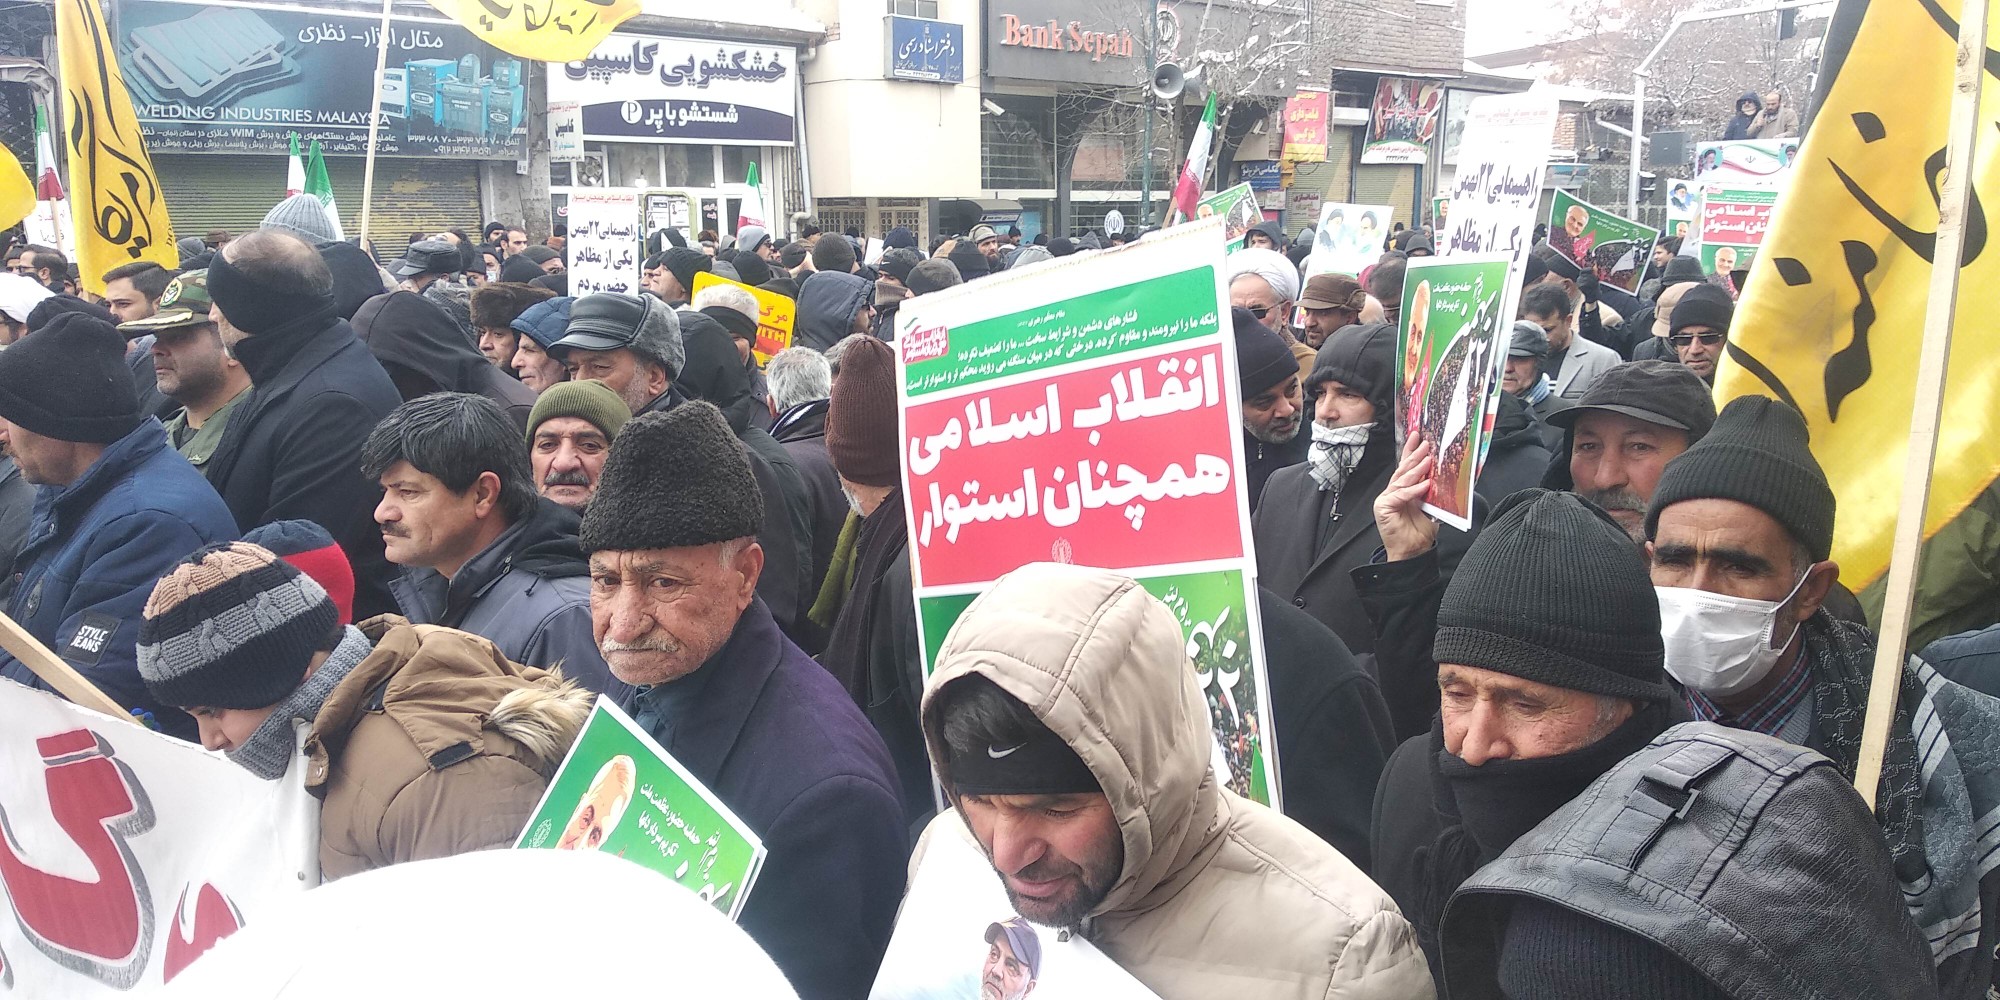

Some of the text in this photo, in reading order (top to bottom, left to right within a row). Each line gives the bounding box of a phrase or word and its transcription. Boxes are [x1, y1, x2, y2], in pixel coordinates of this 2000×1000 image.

[298, 22, 346, 44] نظری
[401, 29, 444, 50] متال
[1000, 14, 1133, 62] Bank Sepah
[899, 32, 955, 60] دفتر اسناد رسمی
[564, 40, 787, 88] خشکشویی کاسپین
[133, 104, 391, 126] WELDING INDUSTRIES MALAYSA
[230, 128, 254, 138] WIM
[281, 129, 303, 140] جش
[362, 143, 381, 151] C2
[1454, 162, 1539, 210] راهپیمایی ۲۲ بهمن
[1705, 205, 1756, 219] اسلامی
[588, 220, 600, 236] ۲۲
[599, 222, 637, 243] راهپیمایی
[1703, 220, 1746, 235] استوار
[1446, 218, 1482, 257] مظاهر
[1501, 225, 1523, 273] یک
[573, 246, 633, 271] یکی از مظاهر
[1104, 309, 1138, 331] فشارهای
[1181, 317, 1189, 333] را
[1190, 315, 1198, 329] ما
[1199, 311, 1217, 327] بلکه
[1048, 326, 1071, 342] شرایط
[1072, 328, 1078, 339] و
[1078, 319, 1102, 338] دشمن
[1118, 328, 1140, 346] مقاوم
[1142, 329, 1148, 341] و
[1149, 319, 1180, 339] نیرومند
[1025, 331, 1047, 347] سخت
[1043, 350, 1052, 362] در
[1052, 344, 1064, 357] که
[1065, 338, 1093, 358] درختی
[1008, 352, 1027, 367] سنگ
[1026, 349, 1043, 365] میان
[958, 364, 979, 381] محکم
[909, 352, 1220, 476] انقلاب اسلامی
[918, 452, 1231, 547] همچنان استوار
[78, 625, 109, 642] STYLE
[70, 635, 102, 653] JEANS
